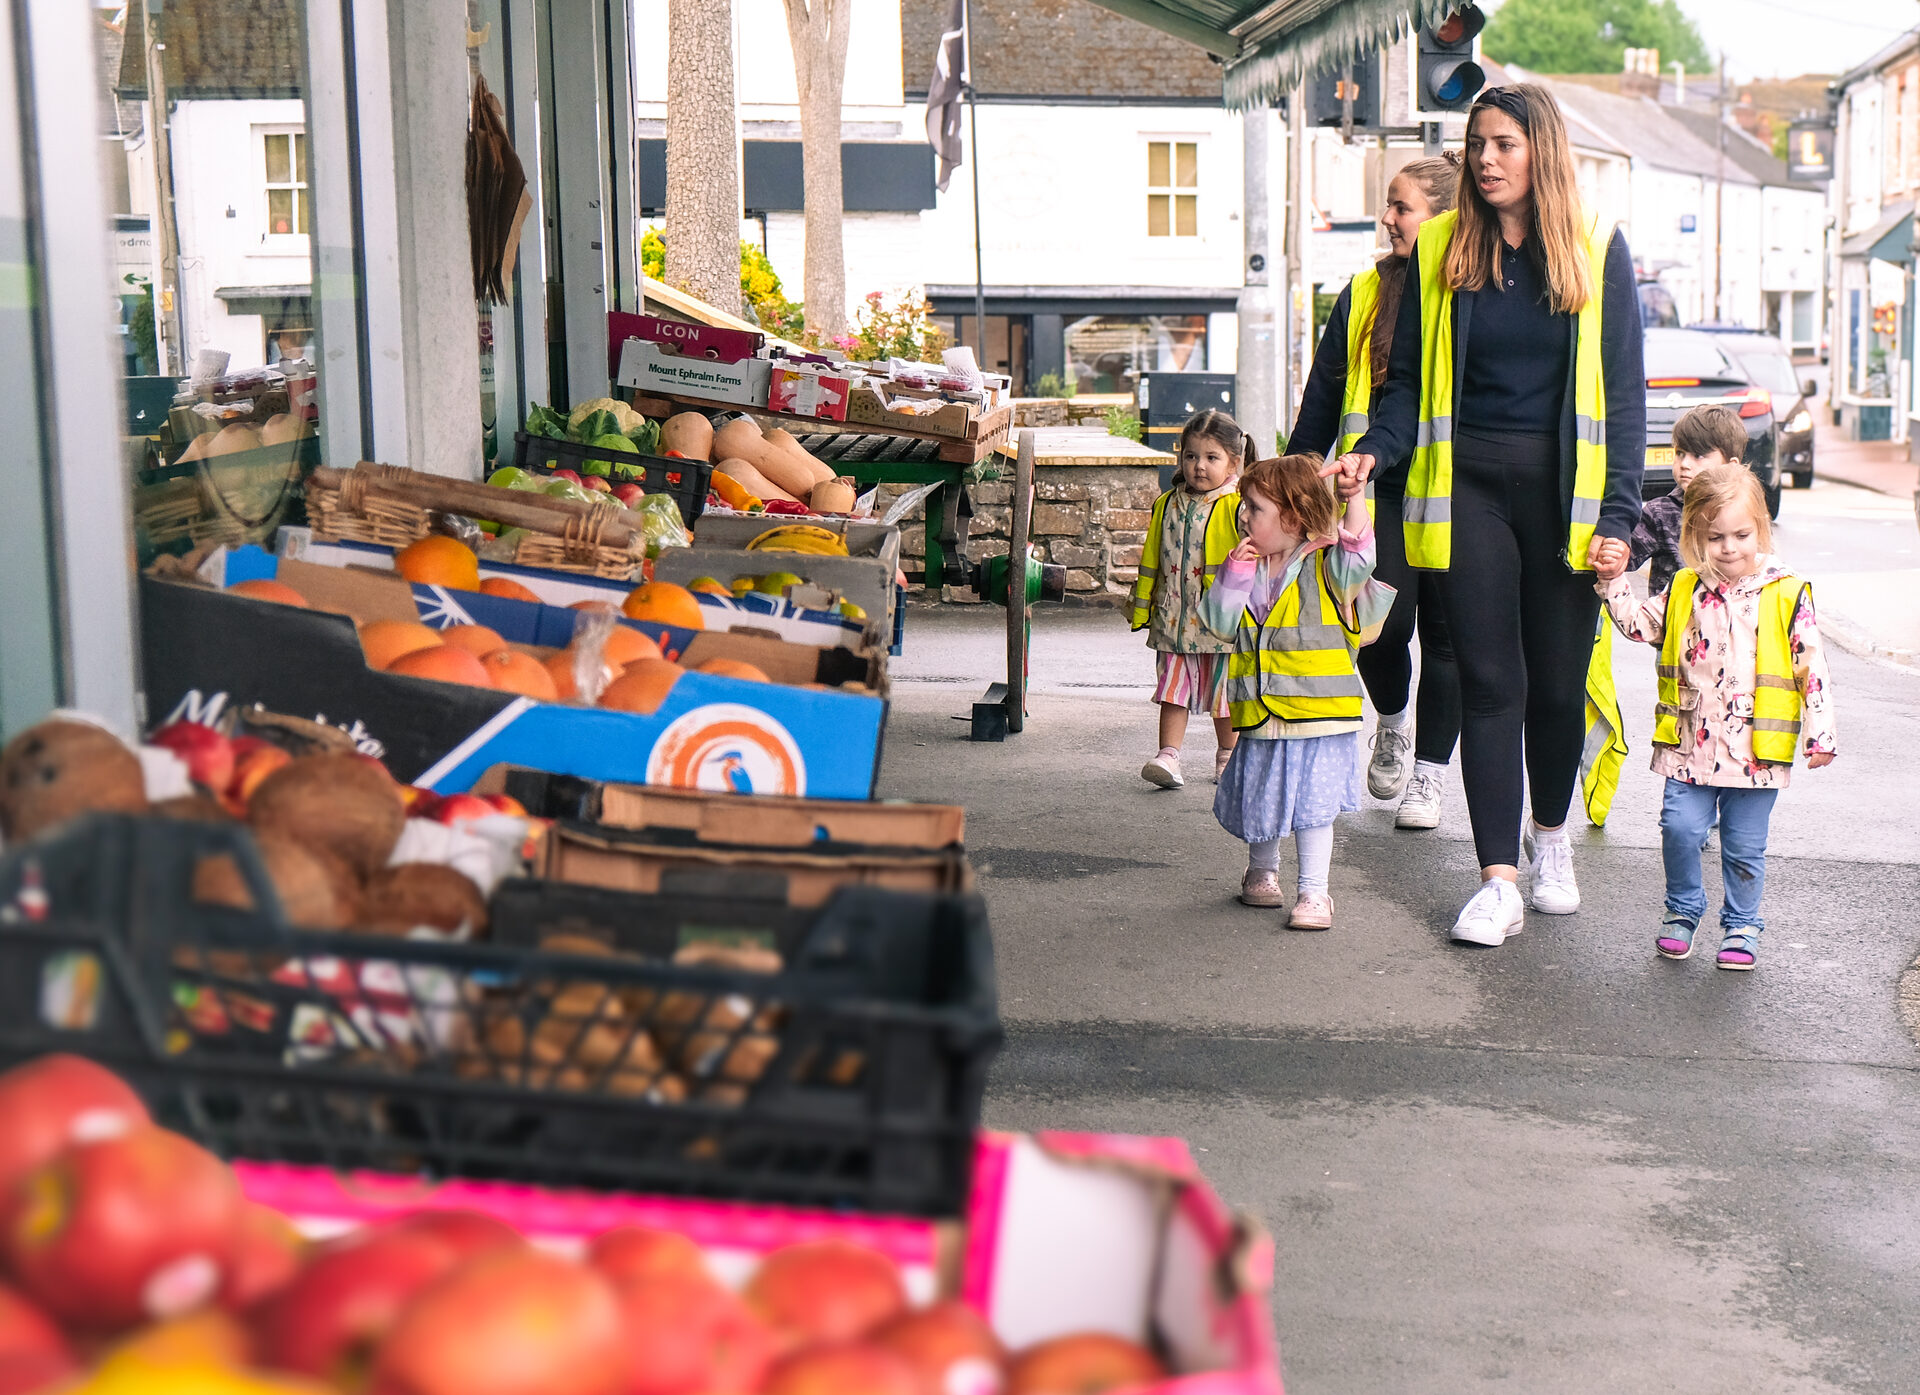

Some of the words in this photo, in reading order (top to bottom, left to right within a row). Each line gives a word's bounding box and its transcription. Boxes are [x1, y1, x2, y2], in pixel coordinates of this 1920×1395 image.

[655, 322, 700, 341] ICON
[648, 363, 677, 376] Mount
[678, 368, 715, 382] Ephraim
[715, 374, 742, 386] Farms
